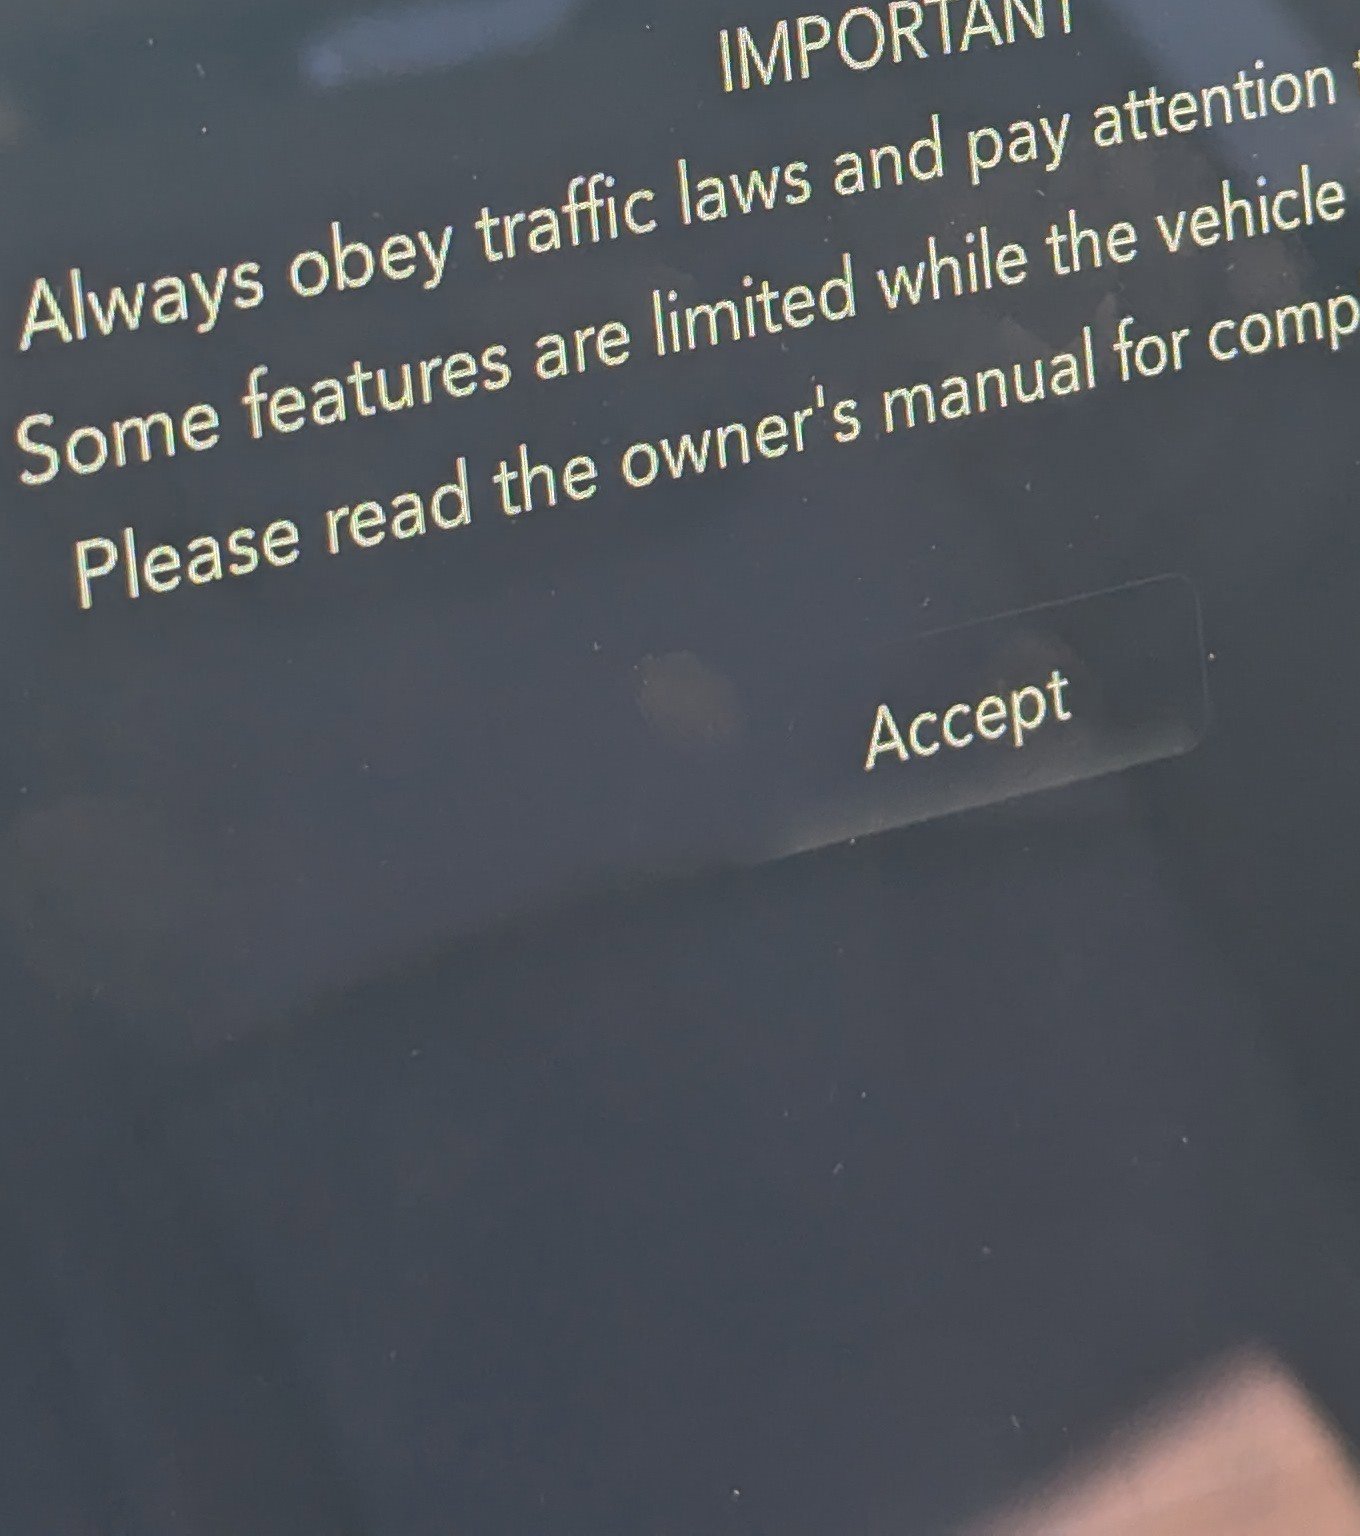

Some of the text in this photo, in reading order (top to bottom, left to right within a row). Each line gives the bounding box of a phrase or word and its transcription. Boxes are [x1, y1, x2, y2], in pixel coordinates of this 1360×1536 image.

[16, 404, 220, 486] Some
[242, 344, 512, 439] features
[535, 318, 630, 380] are
[653, 253, 855, 355] limited
[877, 226, 1028, 310] while
[1045, 209, 1138, 275] the
[1156, 165, 1346, 252] vehicle
[20, 262, 264, 351] Always
[290, 222, 453, 296] obey
[475, 173, 656, 261] traffic
[678, 159, 811, 224] laws
[835, 114, 943, 195] and
[969, 113, 1071, 185] pay
[1093, 60, 1336, 147] attention
[76, 520, 300, 610] Please
[326, 457, 472, 555] read
[493, 444, 598, 516] the
[621, 385, 861, 487] owner's
[883, 327, 1096, 434] manual
[1113, 317, 1190, 382] for
[865, 671, 1072, 771] Accept
